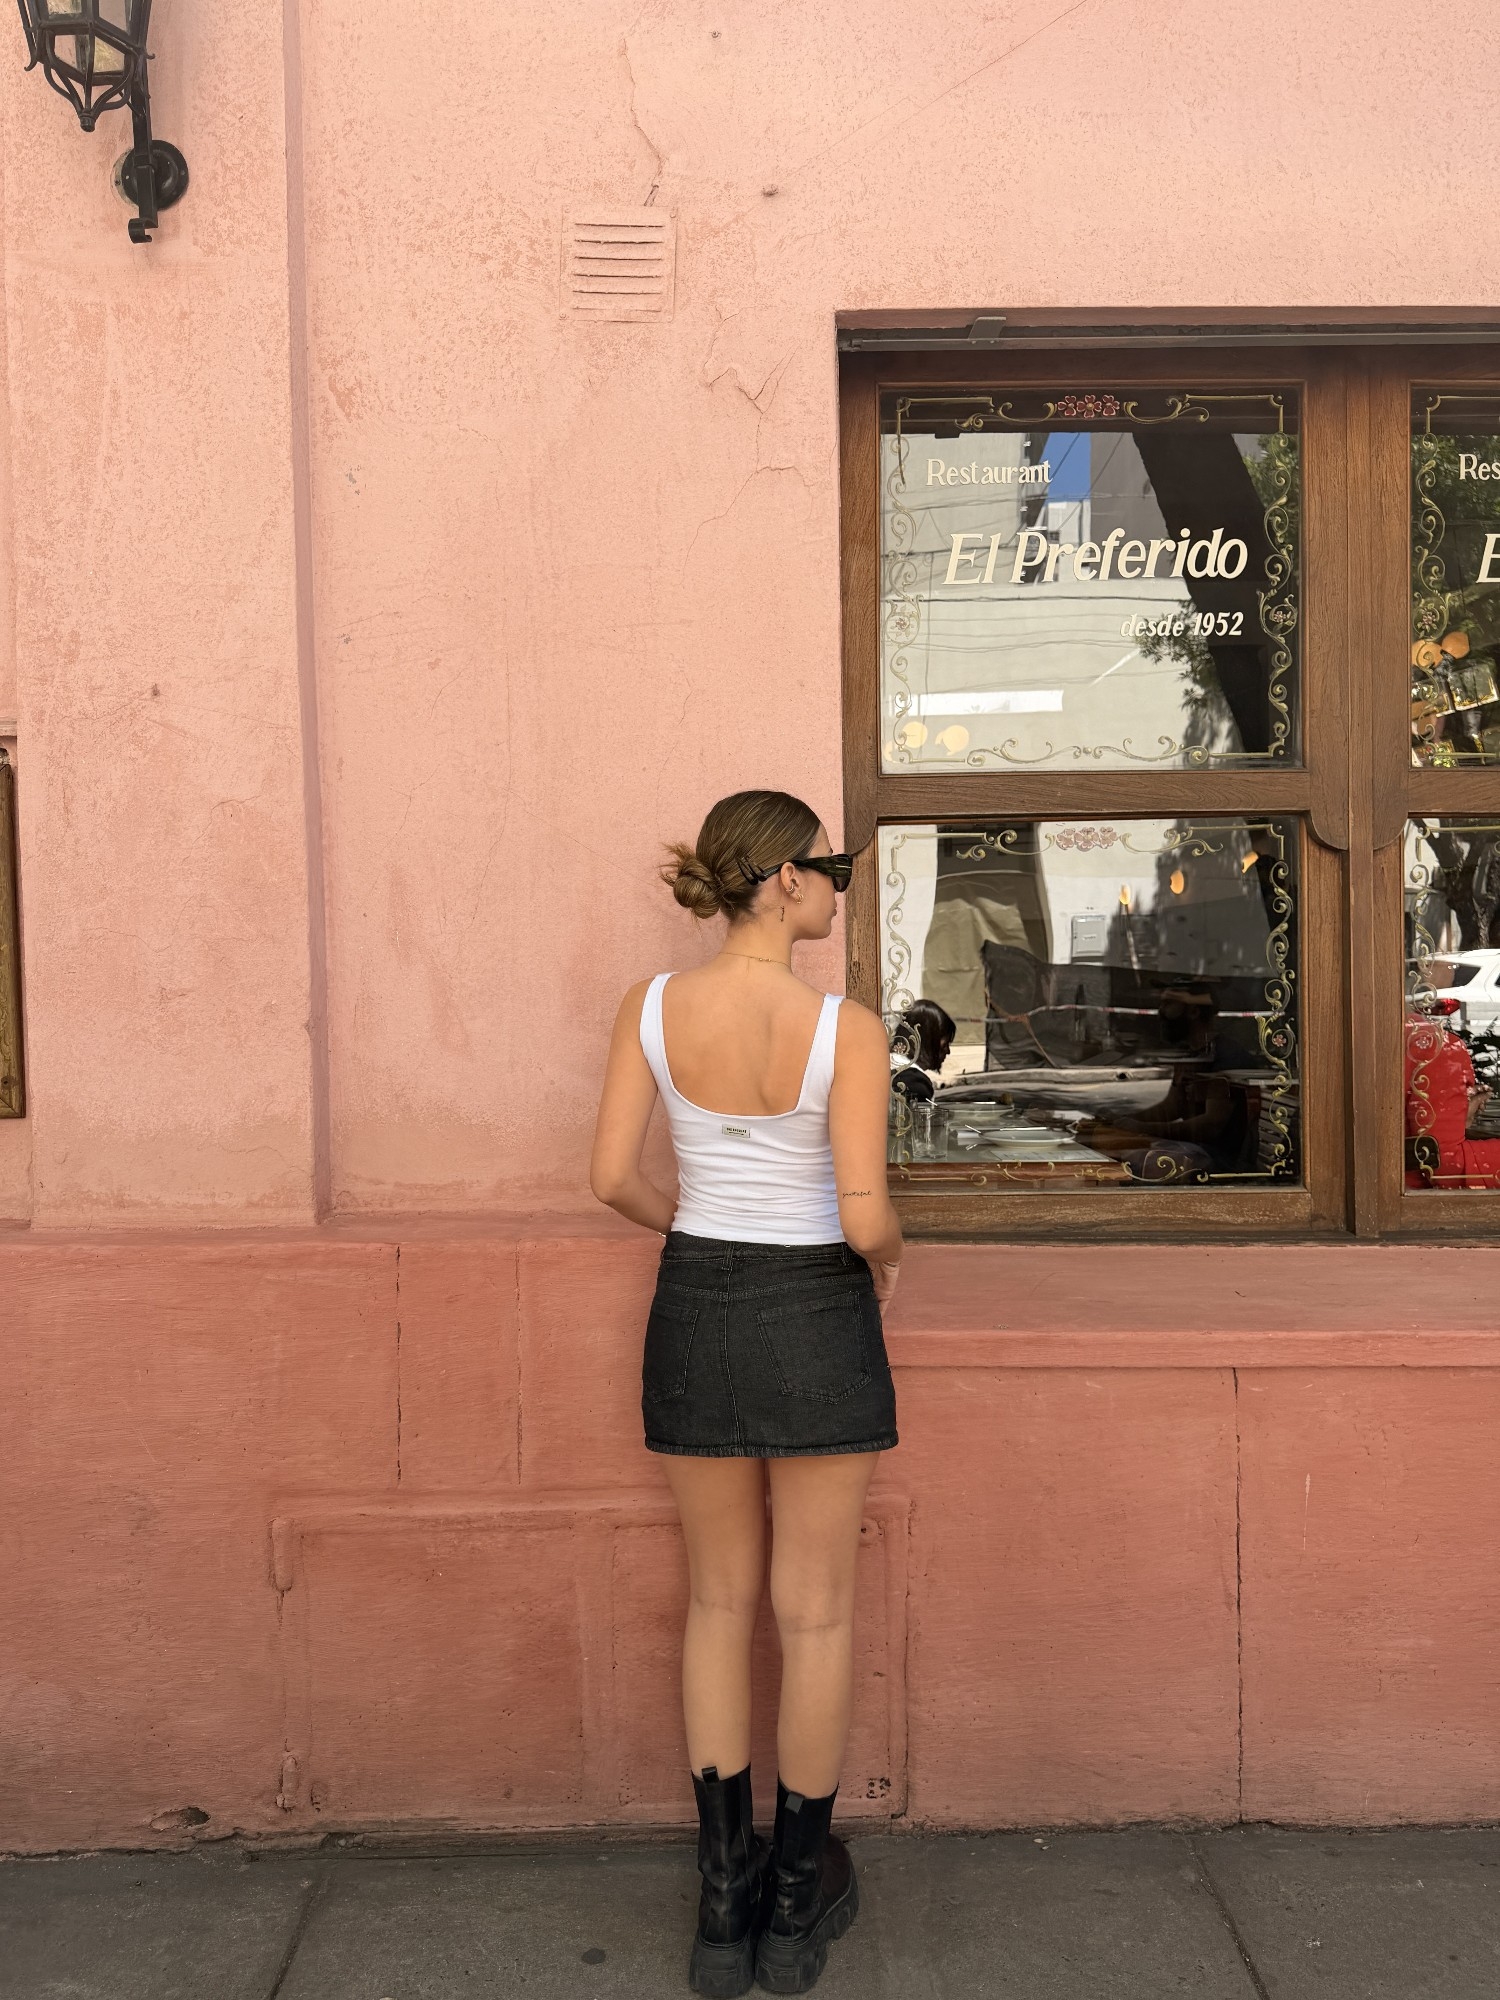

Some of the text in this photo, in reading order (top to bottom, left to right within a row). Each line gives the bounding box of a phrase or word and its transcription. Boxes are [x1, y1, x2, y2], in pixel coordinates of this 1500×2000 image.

[925, 458, 1054, 486] Restaurant
[942, 527, 1248, 585] El Preferido
[1120, 611, 1245, 638] desde 1952
